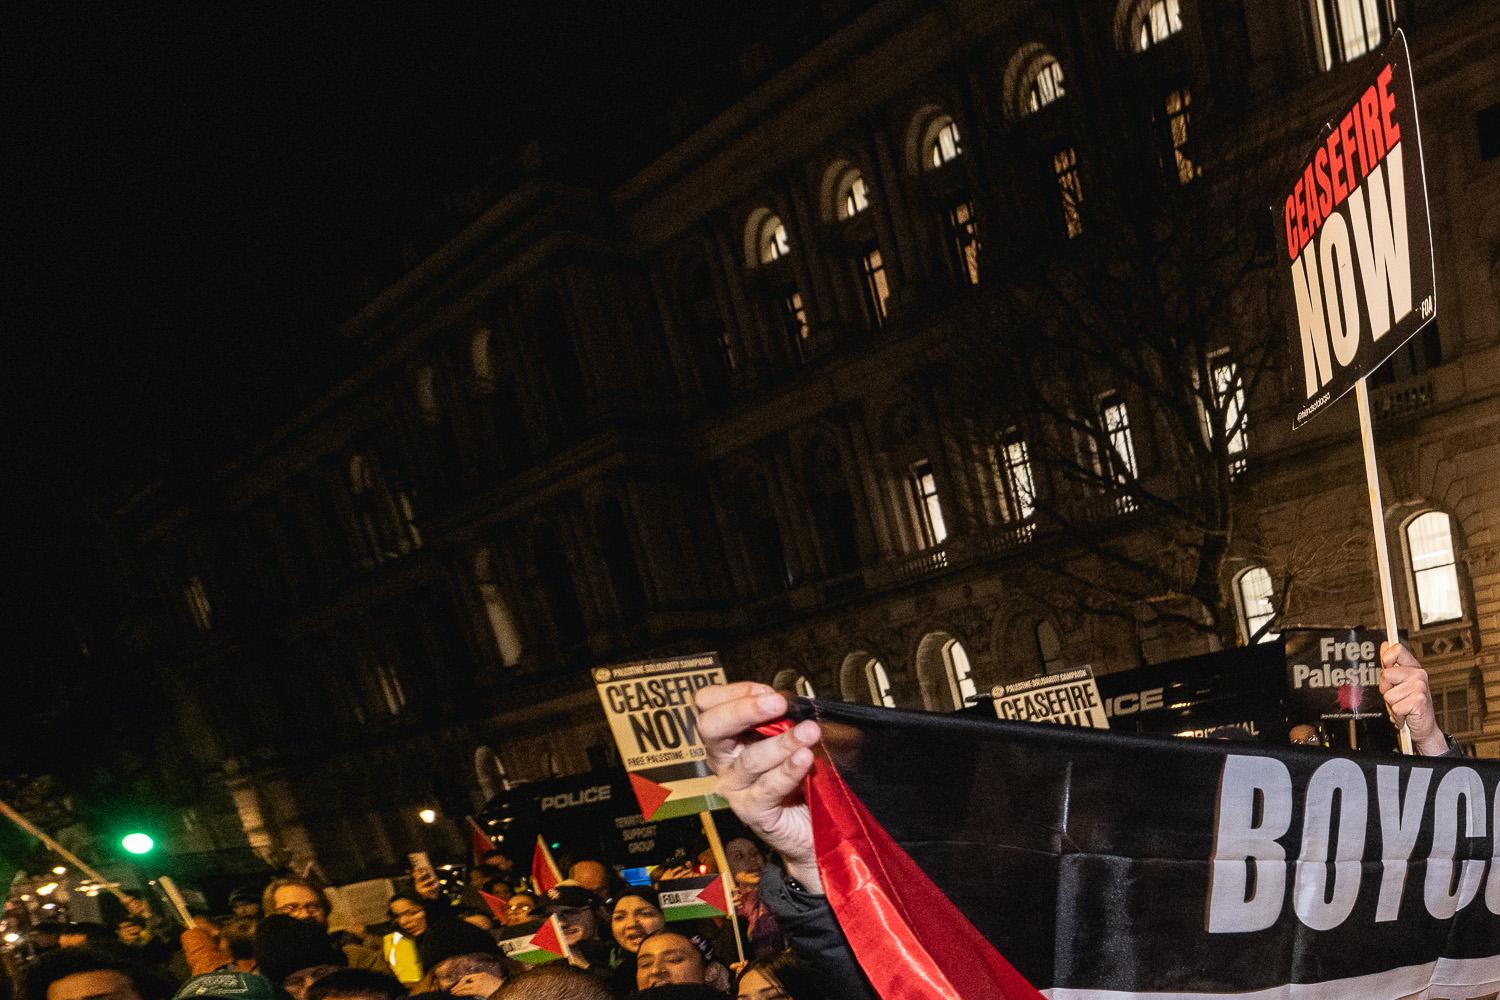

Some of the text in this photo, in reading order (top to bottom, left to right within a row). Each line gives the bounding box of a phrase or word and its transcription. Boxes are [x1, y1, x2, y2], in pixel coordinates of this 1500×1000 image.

[1284, 63, 1401, 261] CEASEFIRE
[1291, 141, 1413, 399] NOW
[1320, 637, 1376, 662] Free
[1293, 662, 1382, 689] Palesti
[1001, 683, 1097, 721] CEASEFIRE
[1105, 688, 1164, 718] ICE
[541, 784, 612, 811] POLICE
